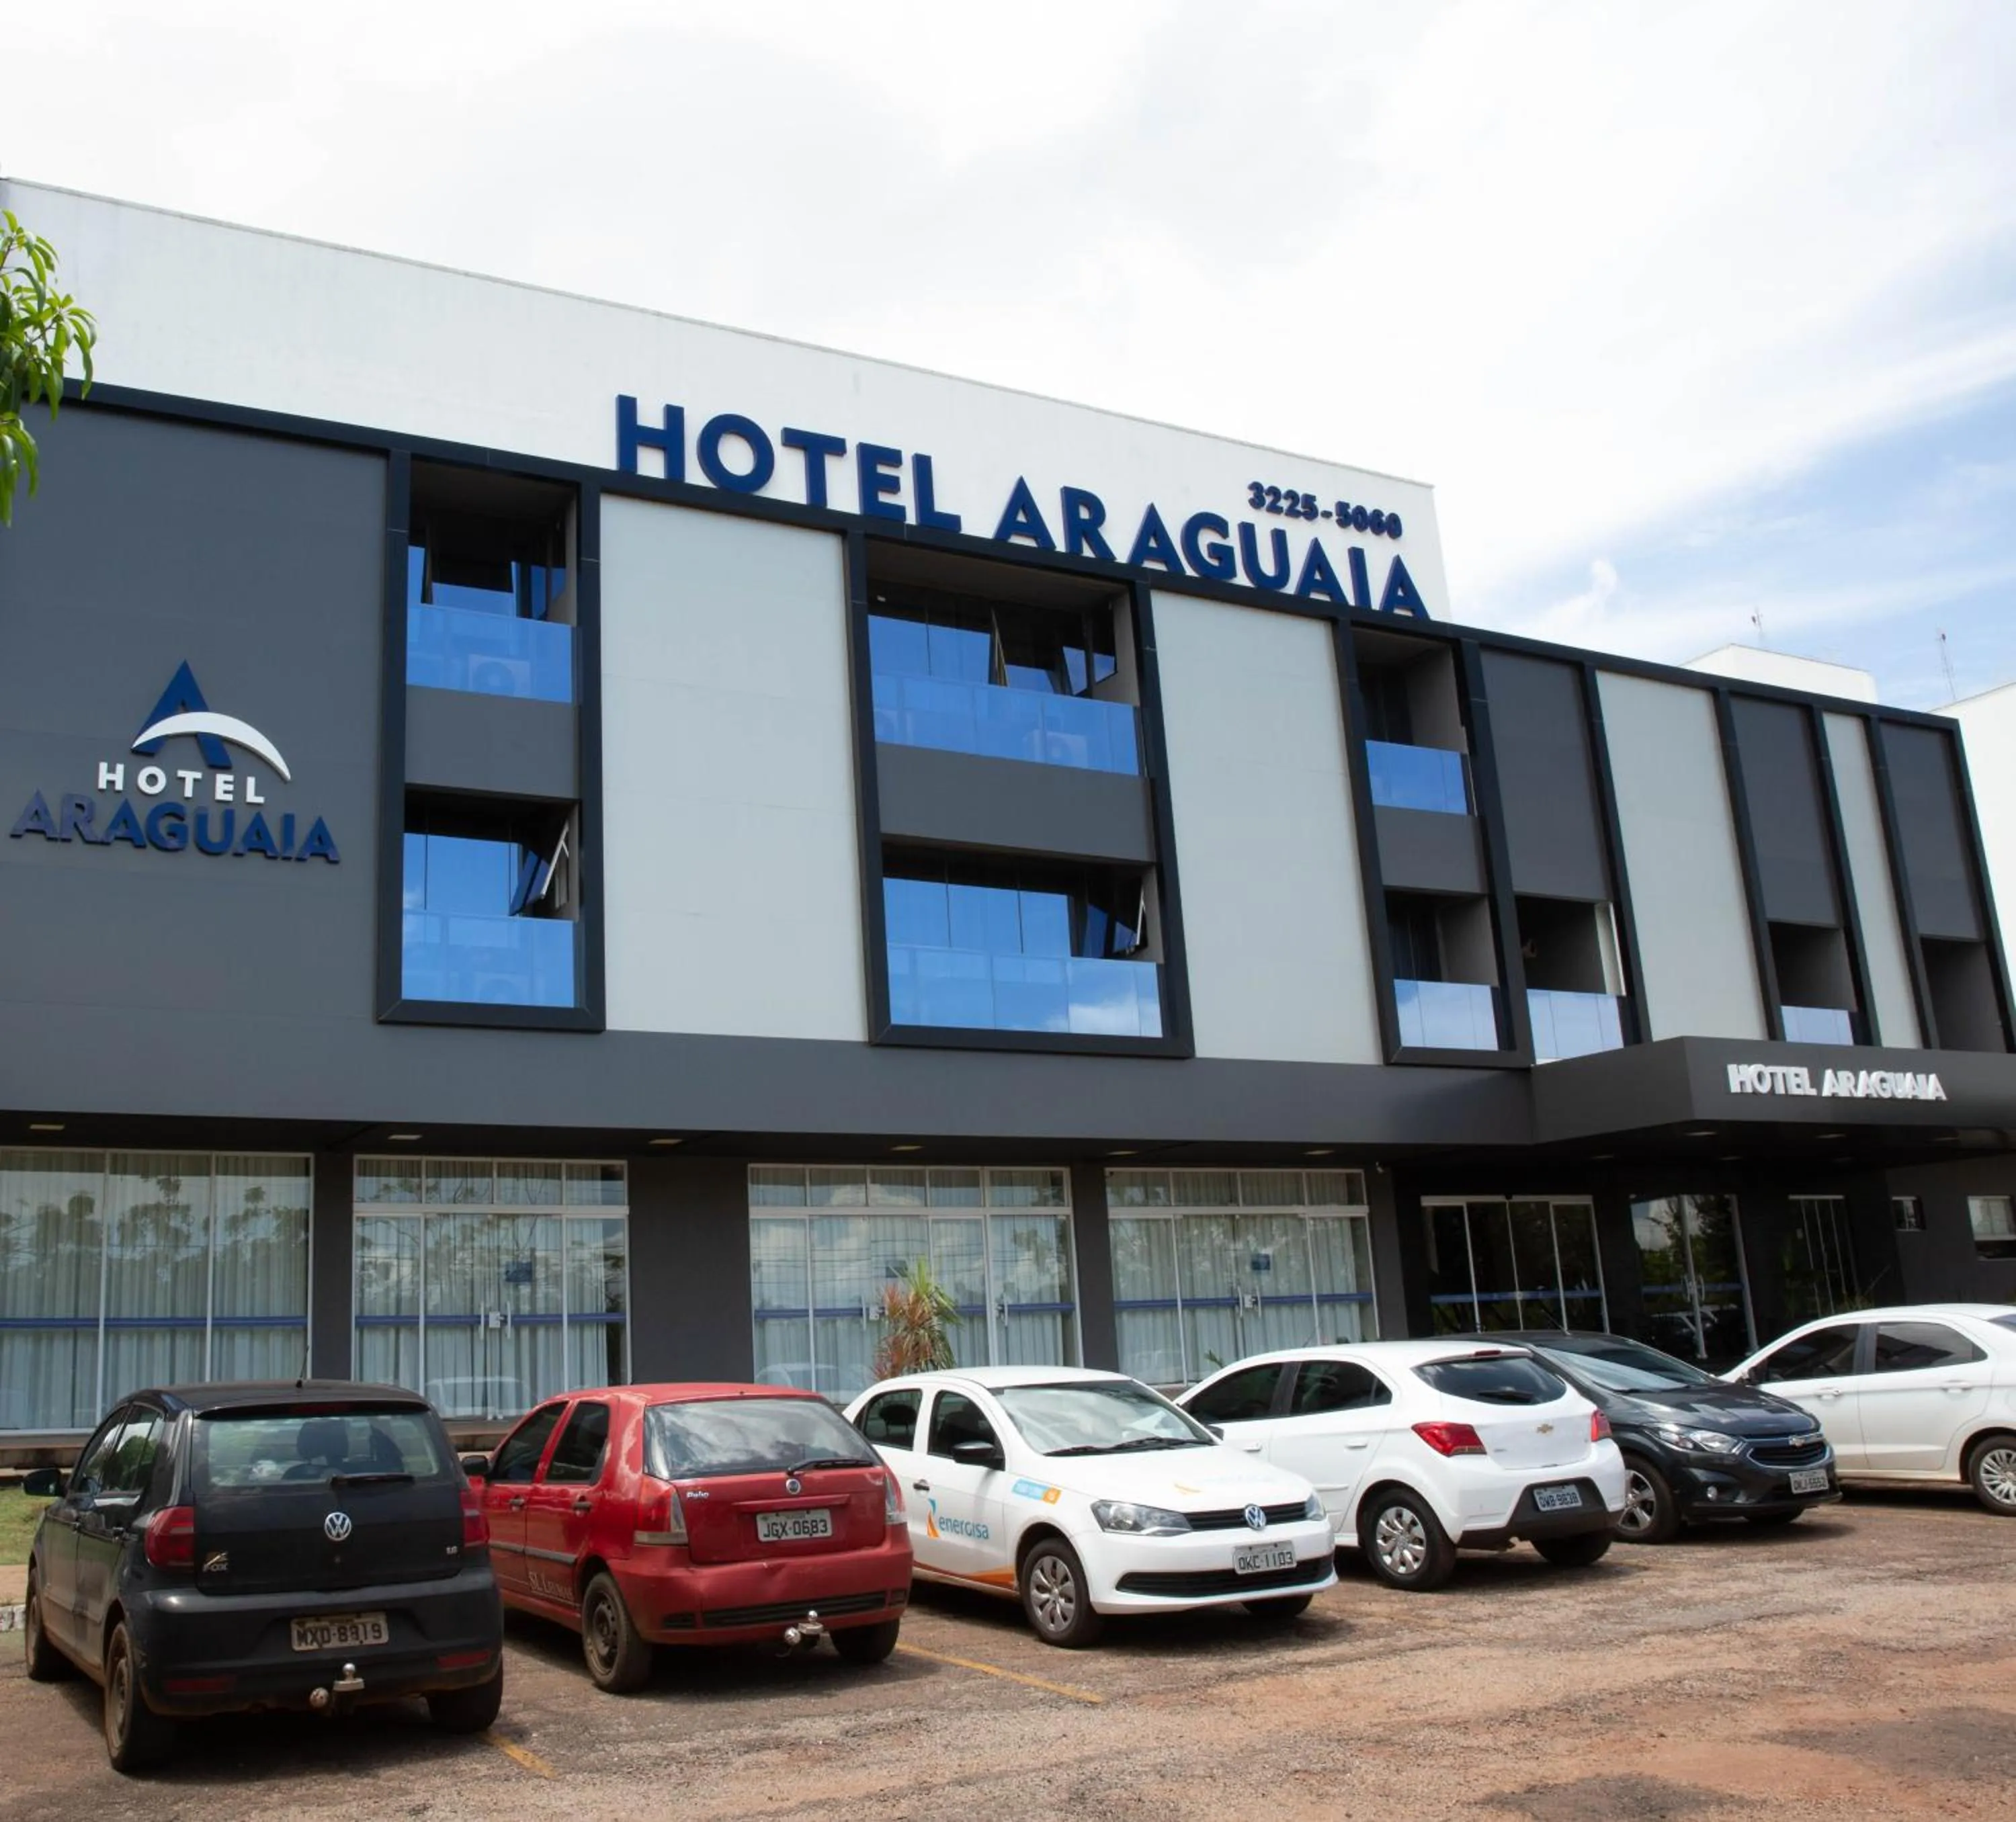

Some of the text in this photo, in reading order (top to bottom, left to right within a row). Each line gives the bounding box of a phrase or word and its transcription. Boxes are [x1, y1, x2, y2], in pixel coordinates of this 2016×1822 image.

[616, 394, 1431, 619] HOTEL ARAGUAIA
[1247, 481, 1402, 539] 3225-5060
[97, 761, 265, 805] HOTEL
[9, 788, 340, 864] ARAGUAIA
[1727, 1064, 1947, 1100] HOTEL ARAGUAIA
[938, 1516, 990, 1540] energisa
